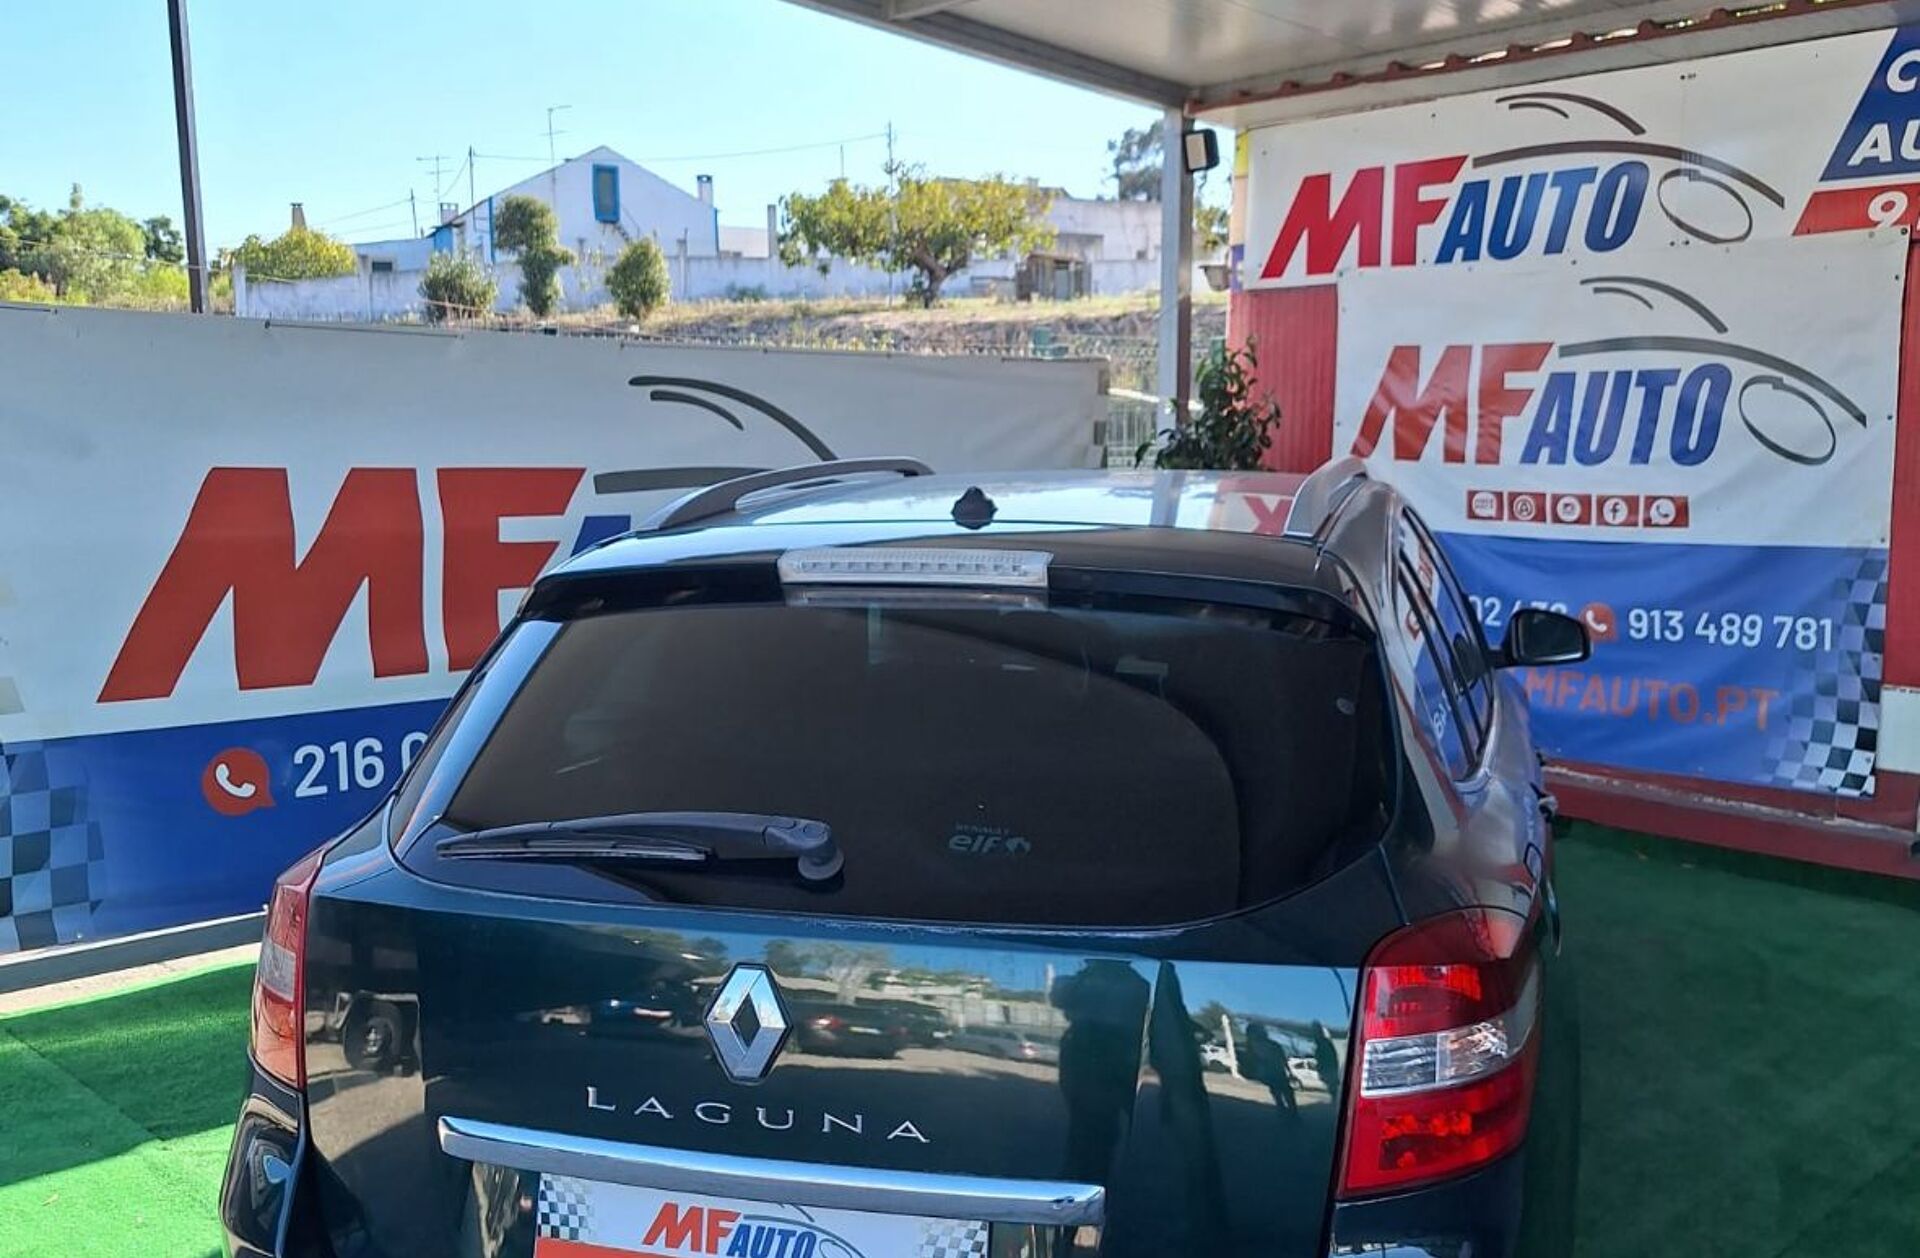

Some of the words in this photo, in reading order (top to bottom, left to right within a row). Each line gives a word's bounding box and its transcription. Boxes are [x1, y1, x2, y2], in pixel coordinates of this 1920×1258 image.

[1868, 191, 1920, 230] 9
[97, 467, 632, 703] MF
[1629, 608, 1683, 641] 913
[1695, 612, 1763, 647] 489
[1773, 615, 1832, 651] 781
[294, 737, 384, 797] 216
[587, 1086, 930, 1143] LAGUNA
